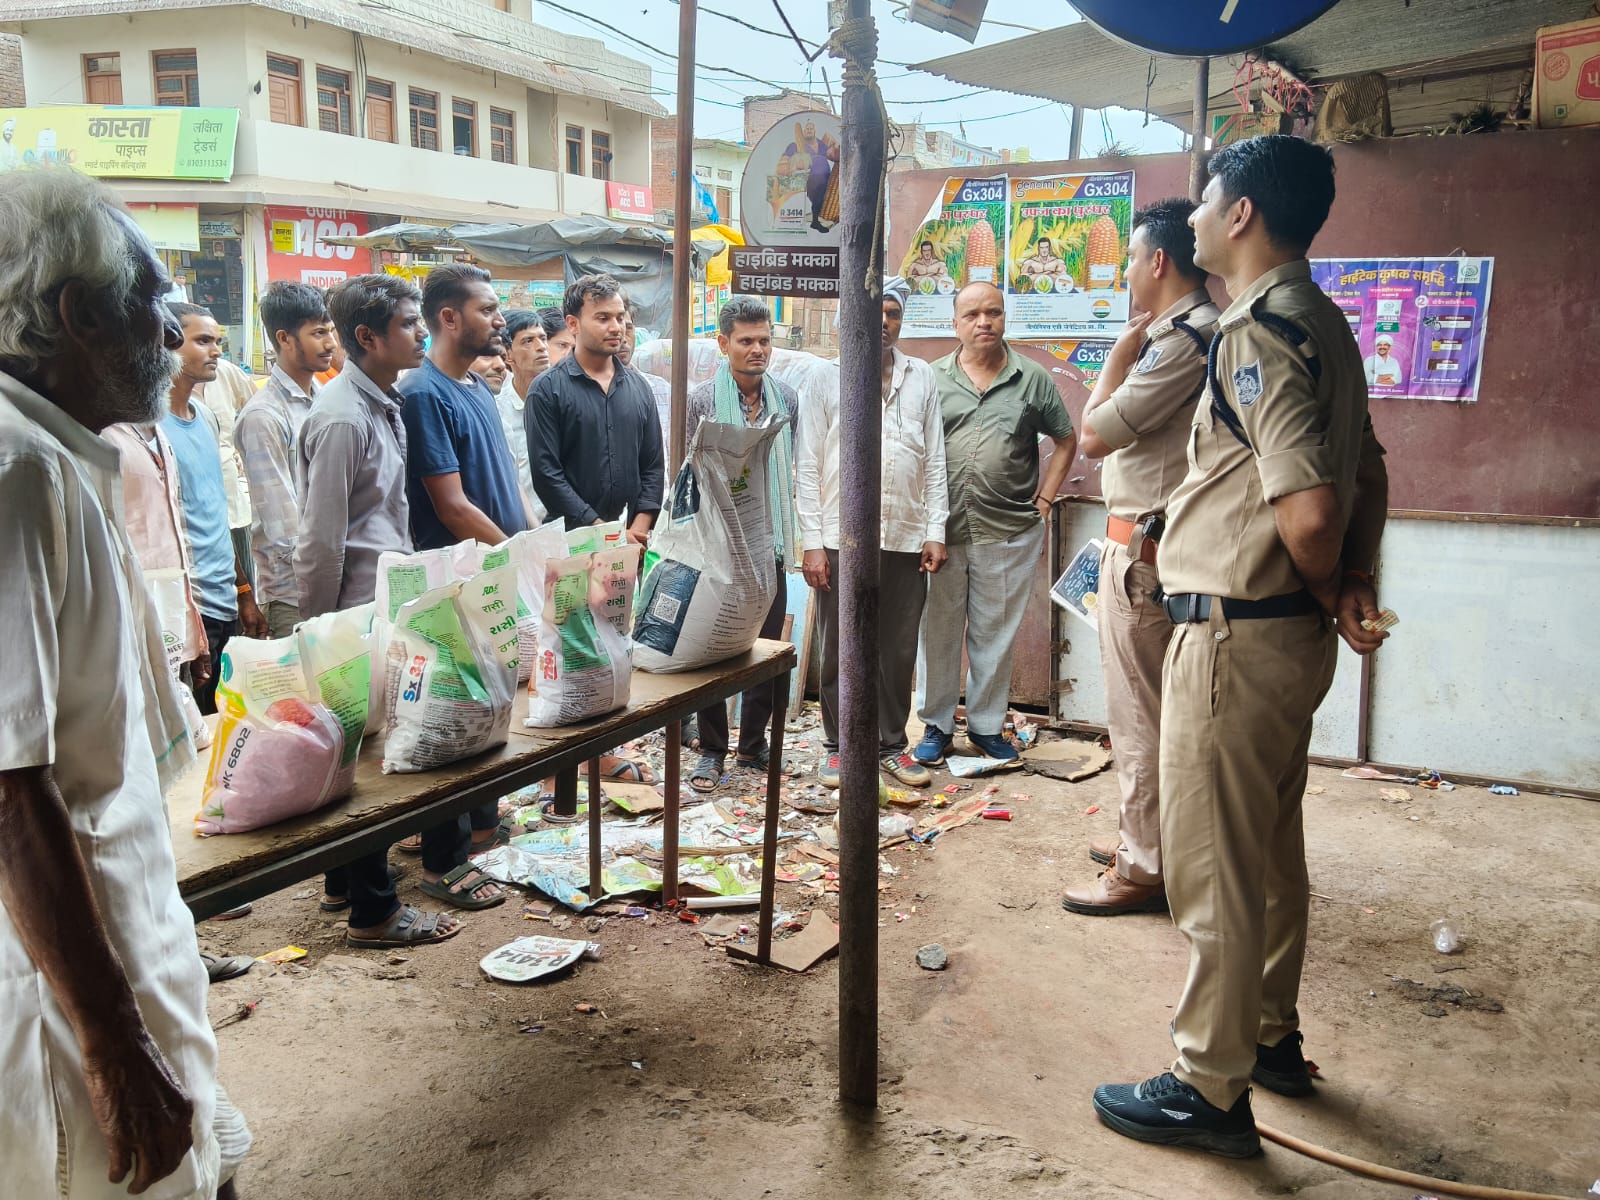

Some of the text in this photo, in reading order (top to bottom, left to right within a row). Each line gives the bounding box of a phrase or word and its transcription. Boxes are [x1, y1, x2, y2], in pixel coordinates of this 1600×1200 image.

[88, 117, 152, 138] कास्ता
[192, 119, 223, 134] लक्षिता
[115, 144, 148, 159] पाइप्स
[962, 187, 1003, 202] Gx304
[1084, 181, 1129, 197] Gx304
[787, 208, 803, 217] 3414
[1021, 207, 1050, 218] उपज
[1052, 206, 1072, 217] का
[734, 247, 838, 270] हाइब्रिड मक्का
[739, 273, 840, 292] हाइब्रिड मक्का
[1077, 348, 1112, 362] Gx30
[223, 727, 251, 790] NK 6802
[548, 955, 570, 967] R
